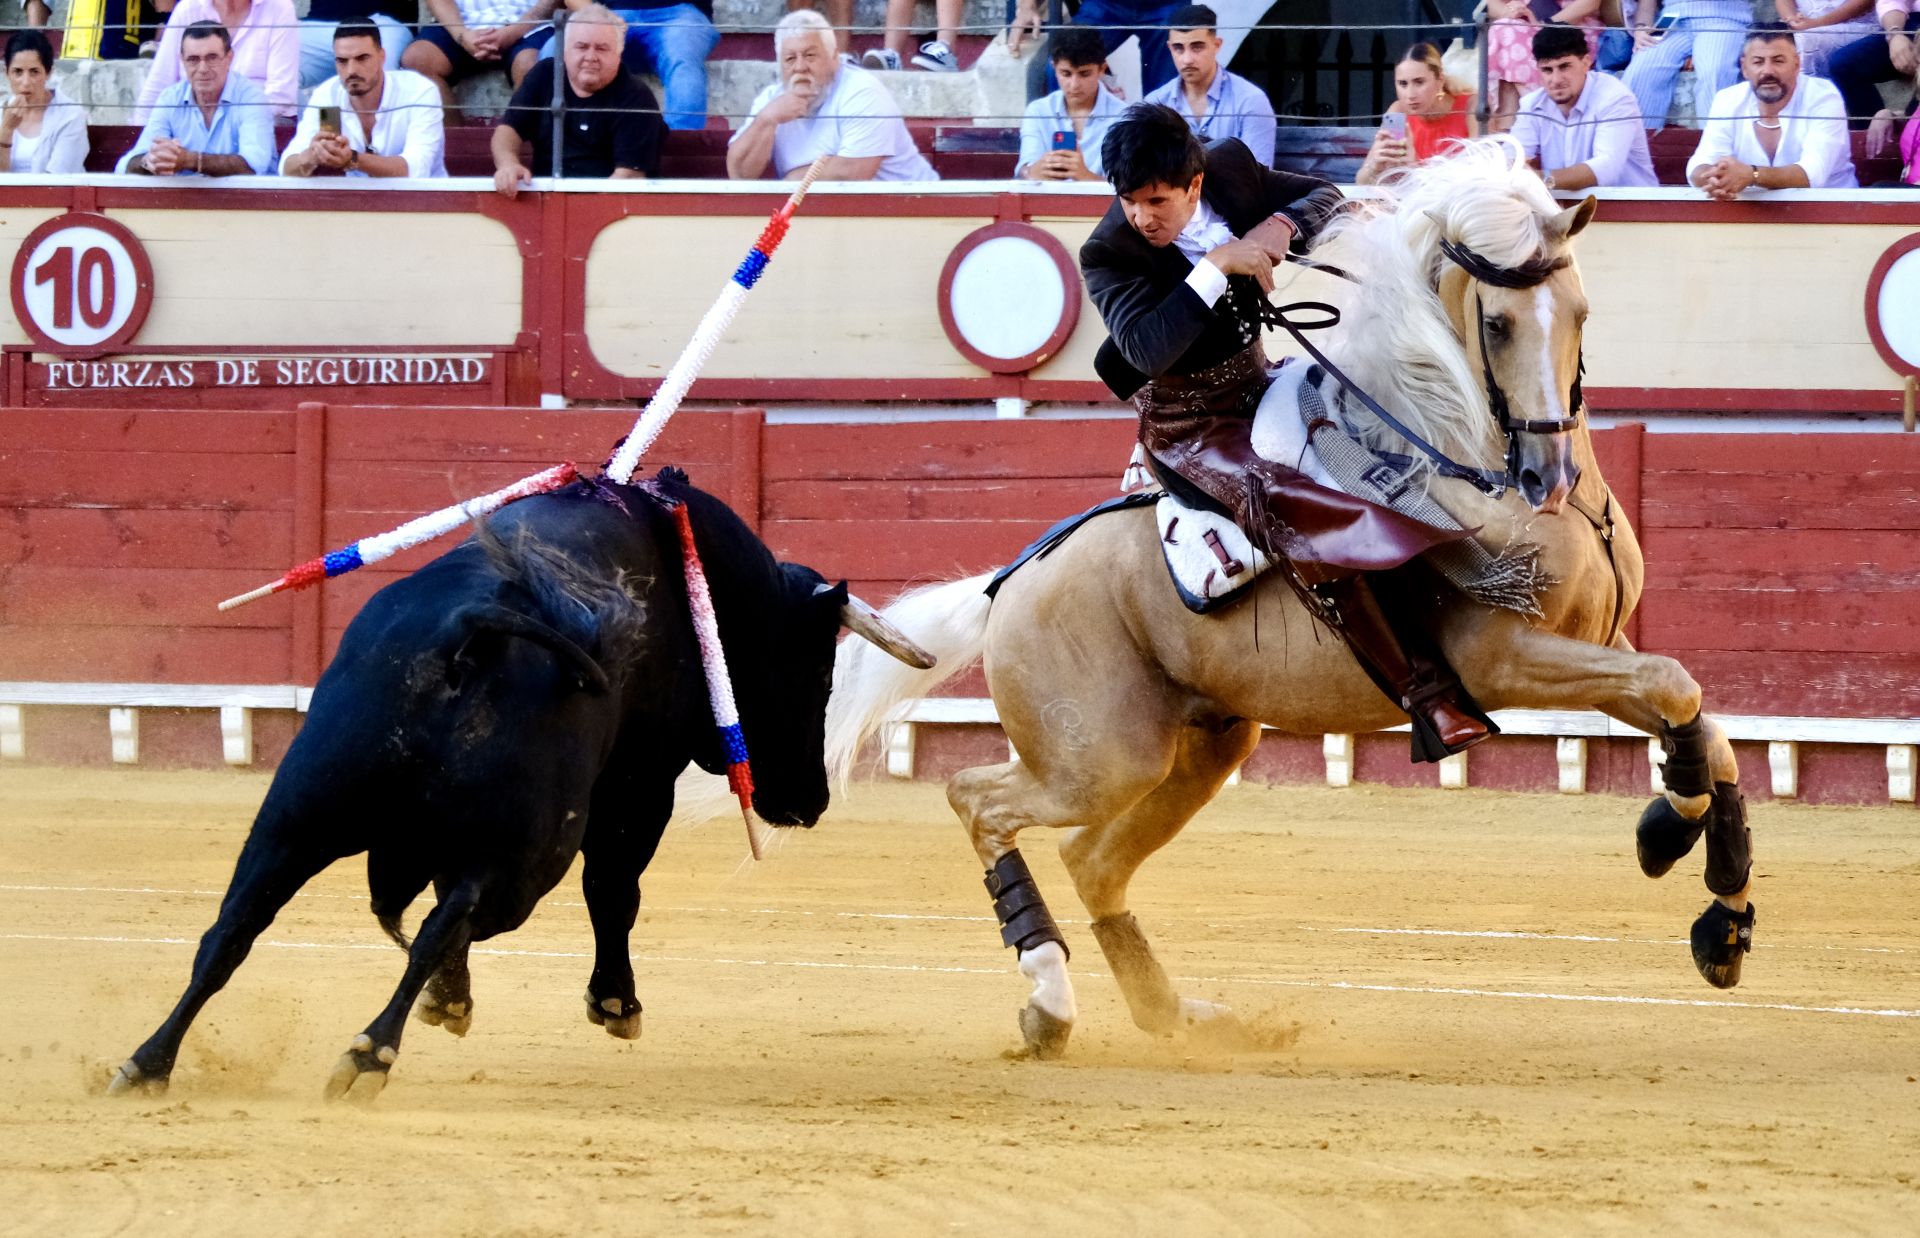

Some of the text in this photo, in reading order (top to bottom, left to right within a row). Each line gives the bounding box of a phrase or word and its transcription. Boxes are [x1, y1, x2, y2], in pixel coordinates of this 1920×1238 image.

[35, 246, 115, 329] 10
[47, 358, 484, 387] FUERZAS DE SEGUIRIDAD
